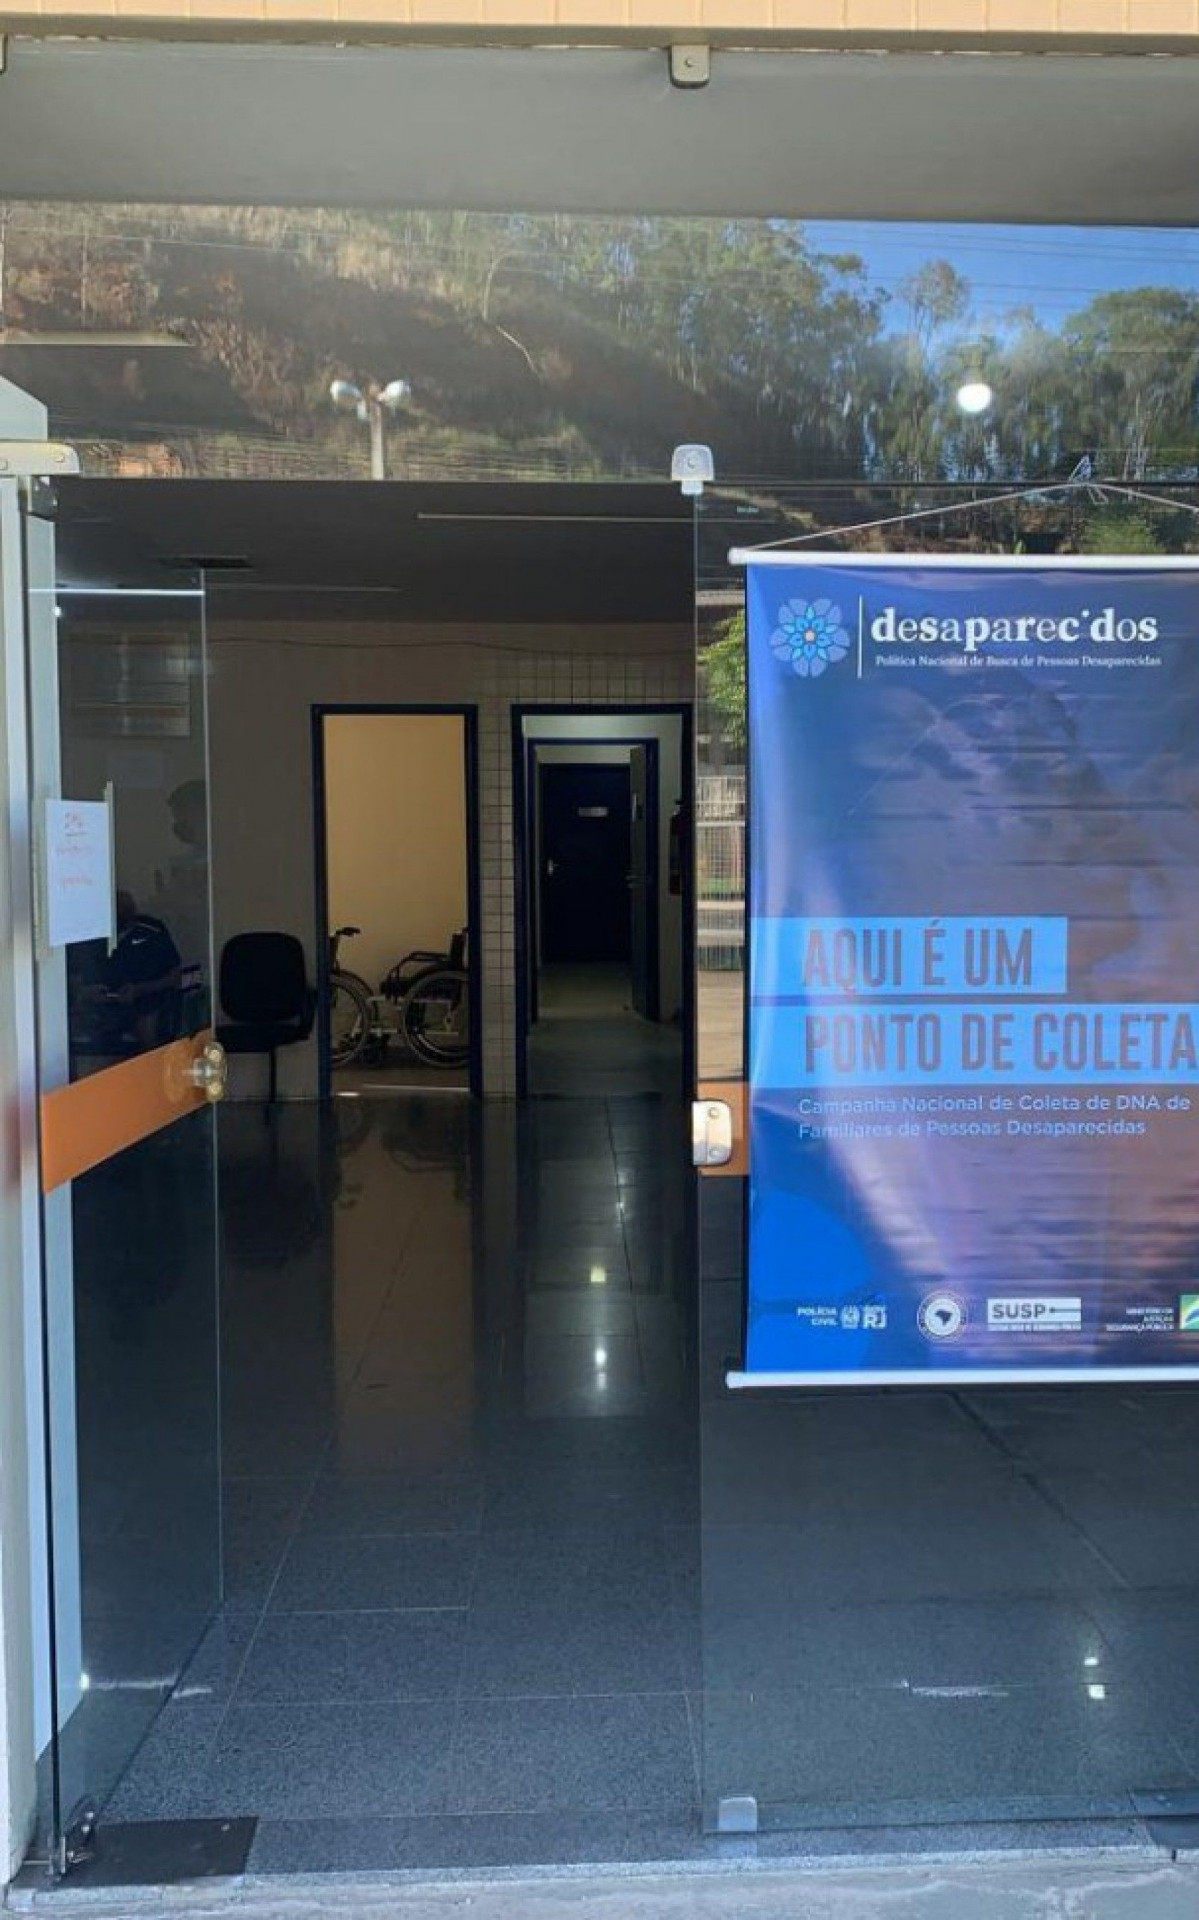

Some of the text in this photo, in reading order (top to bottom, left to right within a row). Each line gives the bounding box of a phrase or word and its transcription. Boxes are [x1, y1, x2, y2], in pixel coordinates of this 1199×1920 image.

[871, 607, 1159, 652] desaparecdos
[919, 654, 967, 667] Nacional
[970, 654, 983, 667] de
[987, 655, 1018, 667] Busca
[1020, 654, 1033, 667] de
[1037, 655, 1079, 667] Pessoas
[804, 919, 1033, 990] AQUI É UM
[805, 1011, 1197, 1073] PONTO DE COLETA
[800, 1094, 1190, 1115] Campanha Nacional de Coleta de DNA de
[799, 1118, 1145, 1139] Familiares de Pessoas Desaparecidas
[991, 1303, 1047, 1319] SUSP
